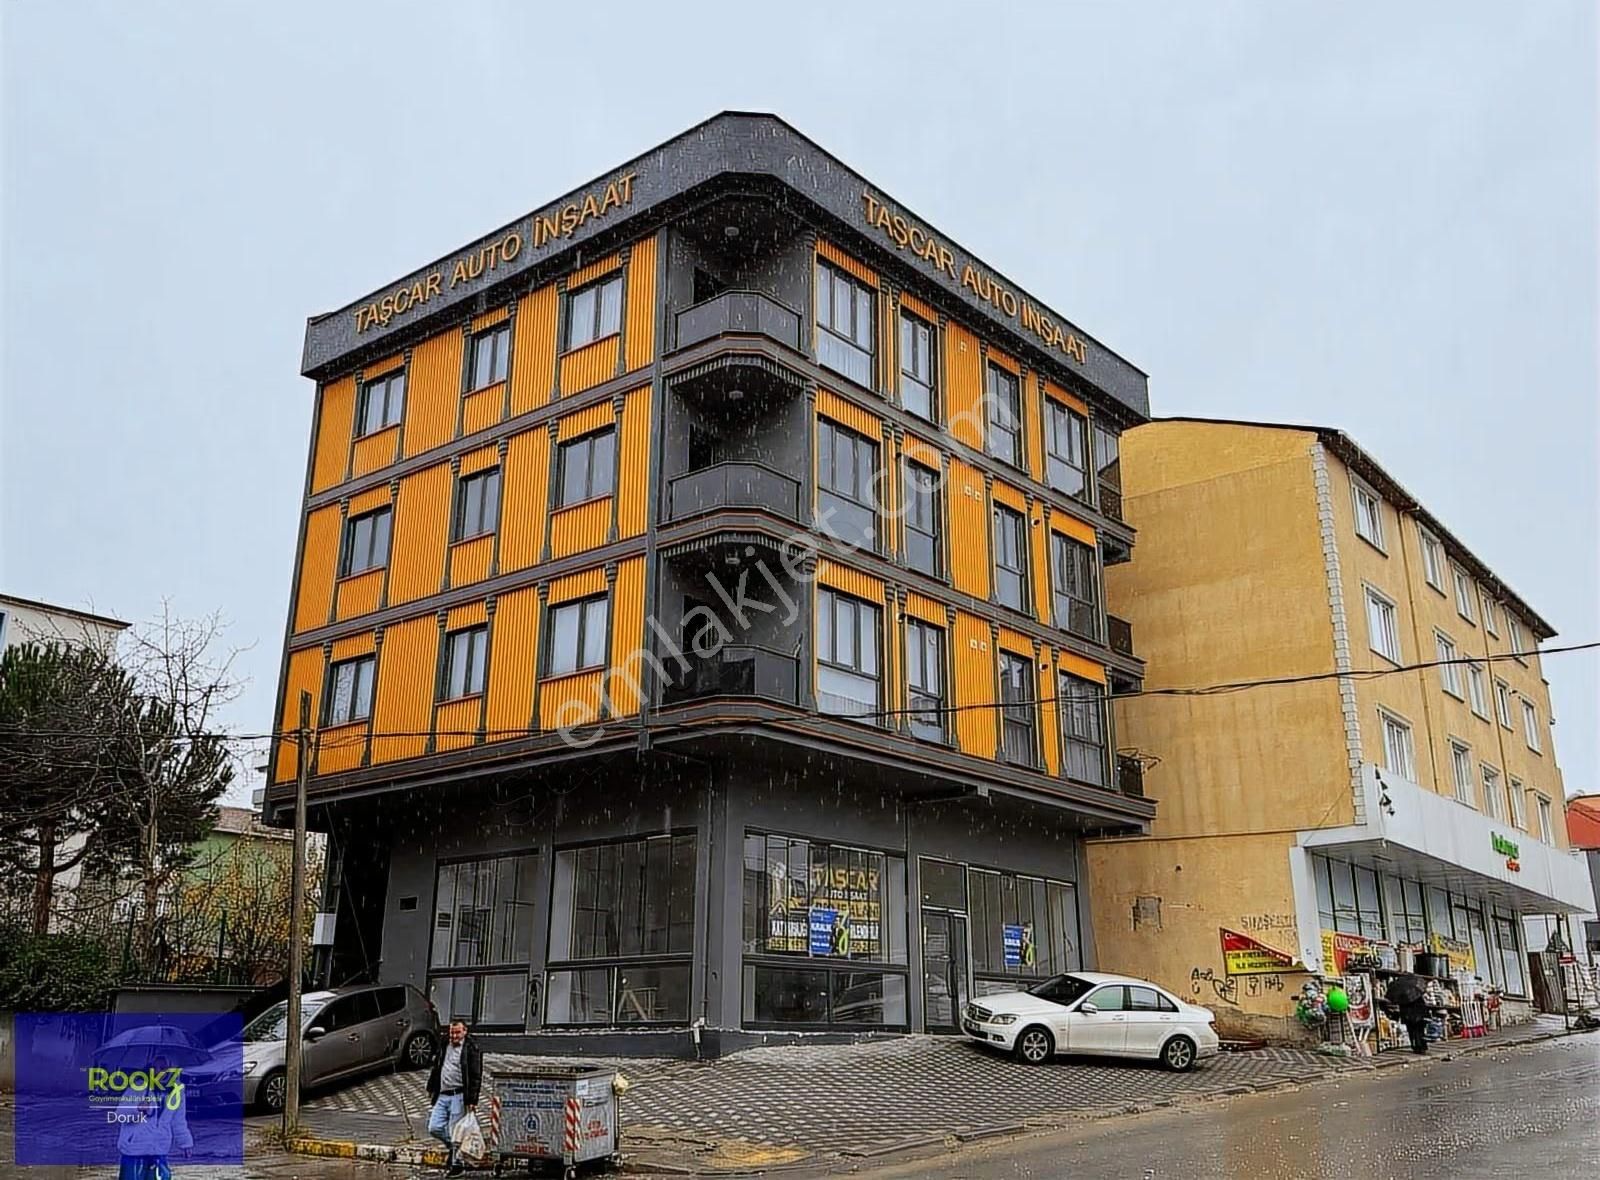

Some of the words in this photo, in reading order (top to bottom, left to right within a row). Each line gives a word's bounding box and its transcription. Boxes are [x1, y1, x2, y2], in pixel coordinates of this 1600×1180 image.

[354, 272, 442, 334] TAŞCAR
[450, 233, 522, 290] AUTO
[532, 172, 637, 248] İNŞAAT
[861, 190, 957, 280] TAŞCAR
[961, 263, 1018, 317] AUTO
[1020, 299, 1088, 366] İNŞAAT
